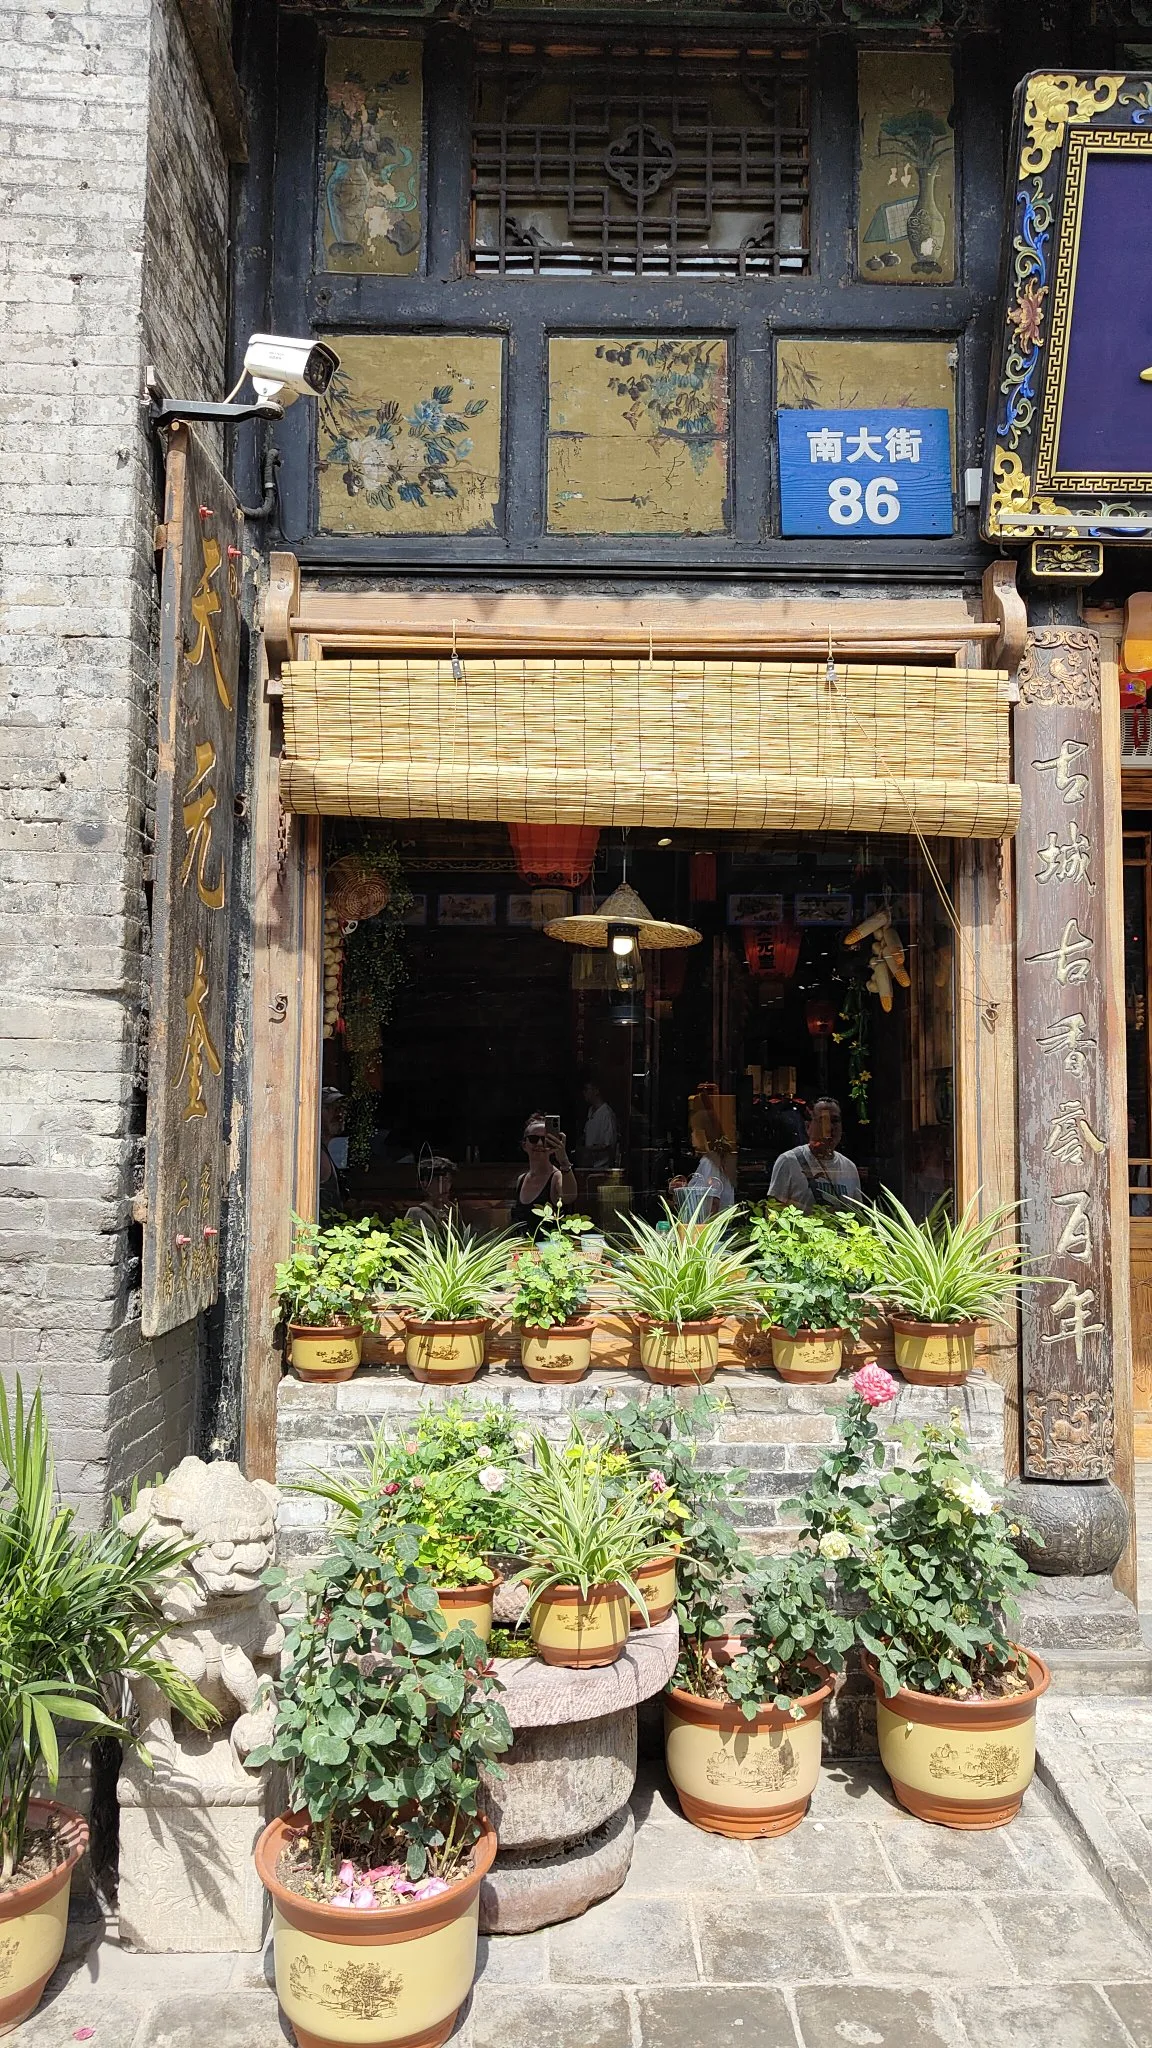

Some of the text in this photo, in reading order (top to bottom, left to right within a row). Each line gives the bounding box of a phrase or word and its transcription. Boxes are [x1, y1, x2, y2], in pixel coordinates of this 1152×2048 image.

[807, 427, 922, 463] 南大街
[828, 477, 900, 525] 86
[171, 537, 232, 1122] 天元奎
